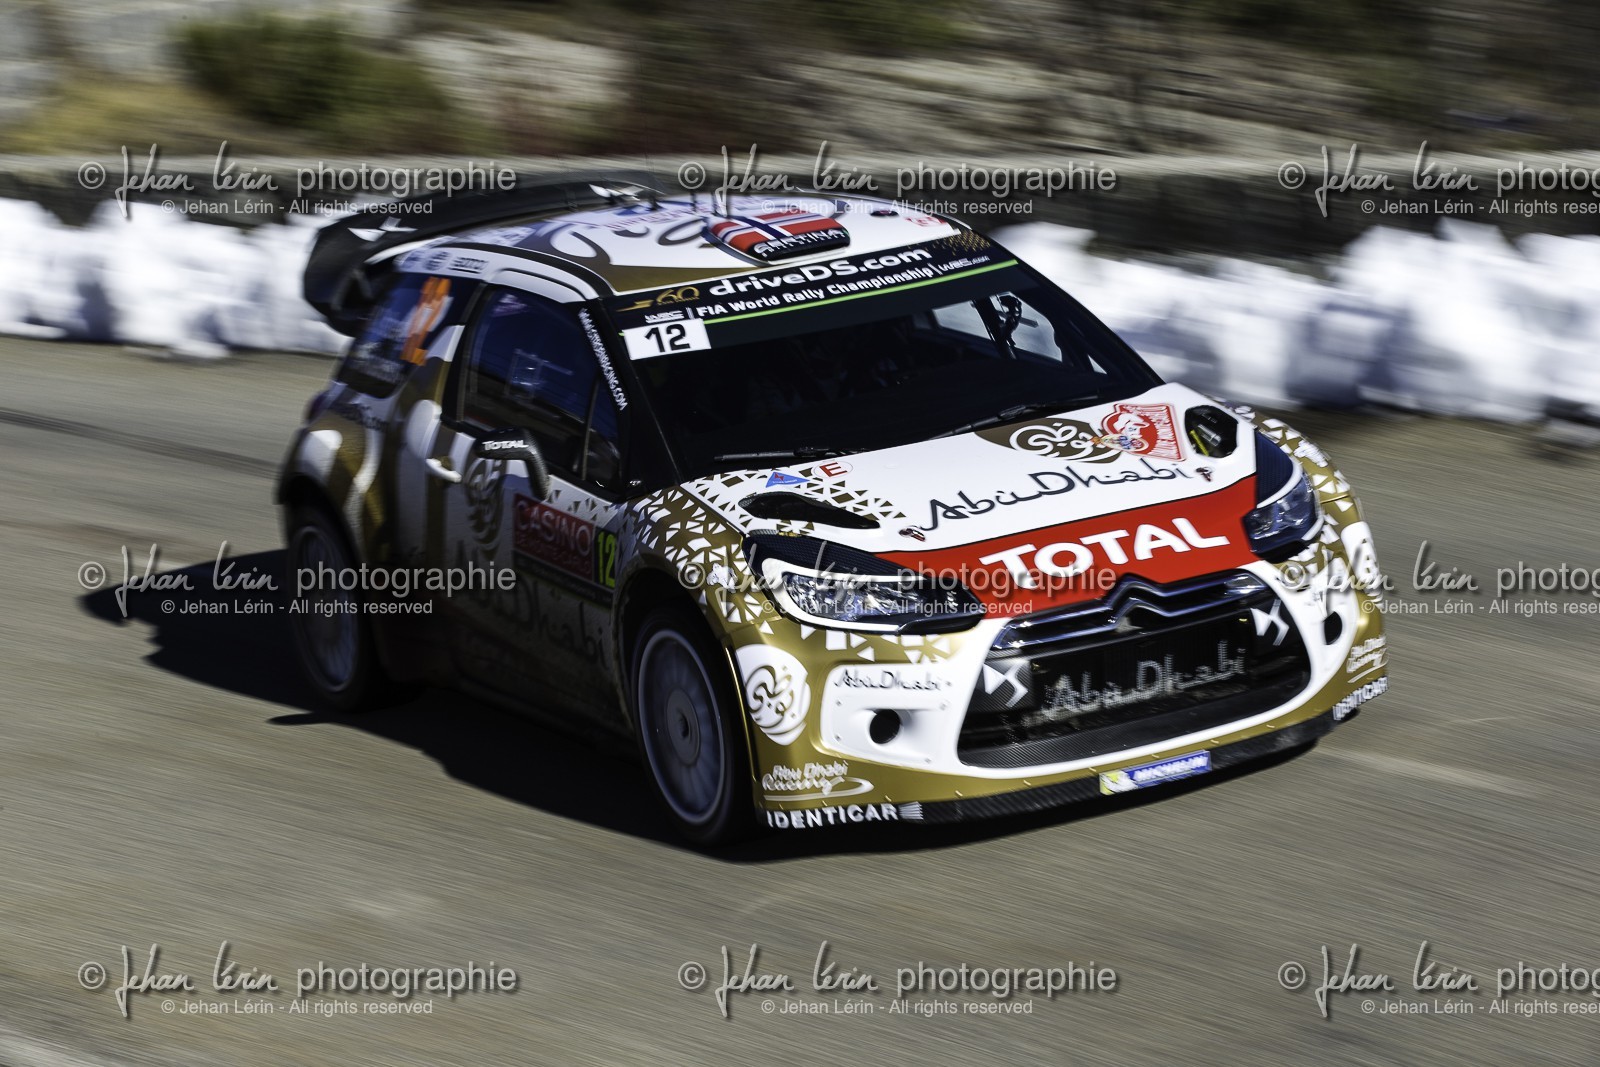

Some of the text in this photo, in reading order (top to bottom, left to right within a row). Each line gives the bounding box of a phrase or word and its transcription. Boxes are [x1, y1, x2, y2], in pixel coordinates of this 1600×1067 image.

[709, 249, 932, 296] driveDS.com
[696, 265, 933, 318] FIA World Rally Championship
[644, 324, 691, 352] 12
[482, 440, 529, 450] TOTAL
[819, 462, 848, 477] E
[516, 500, 591, 557] CASINO
[597, 531, 616, 589] 12
[979, 517, 1230, 589] TOTAL
[804, 760, 848, 778] Dhabi
[767, 803, 899, 829] IDENTICAR
